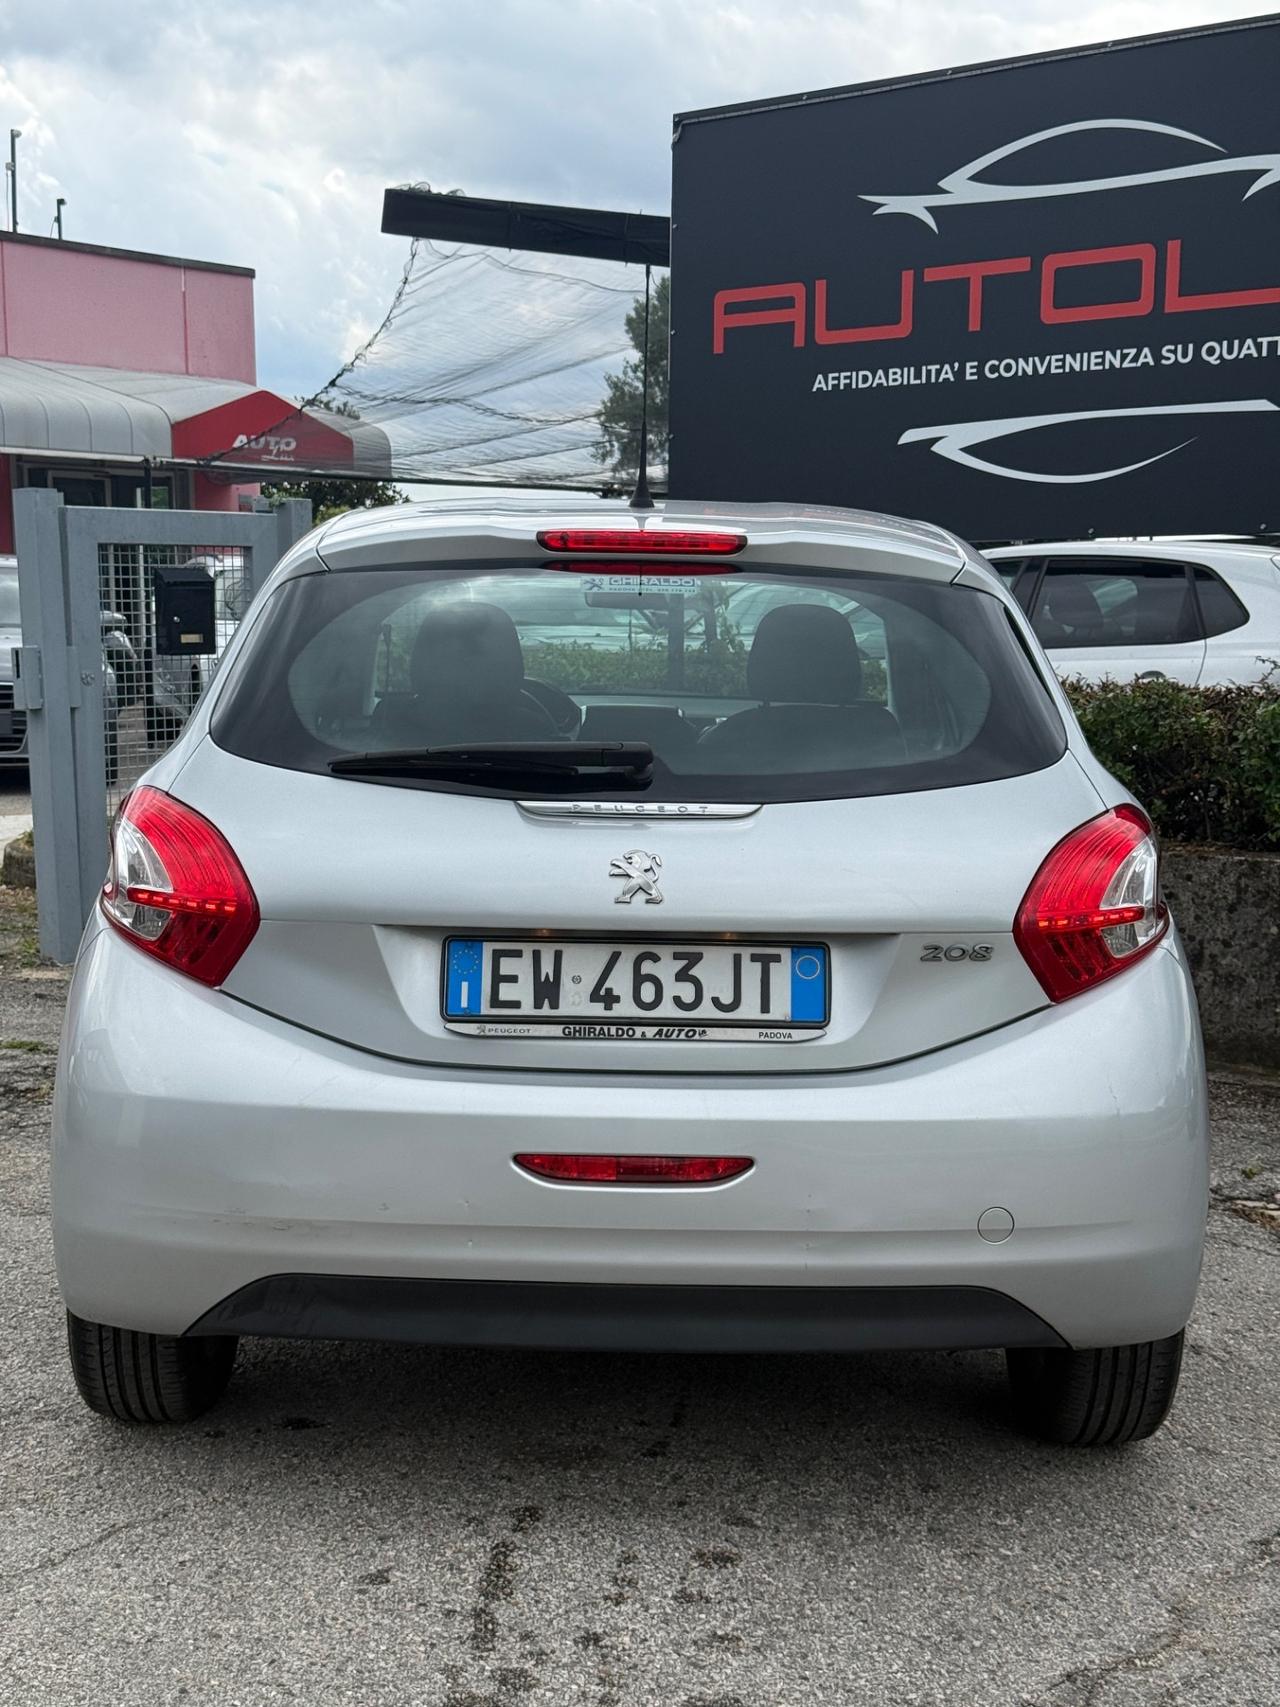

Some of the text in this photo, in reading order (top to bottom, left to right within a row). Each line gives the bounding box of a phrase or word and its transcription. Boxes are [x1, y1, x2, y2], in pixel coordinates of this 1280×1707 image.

[713, 239, 1280, 354] AUTOL
[965, 361, 979, 381] E
[984, 346, 1155, 379] CONVENIENZA
[1160, 343, 1194, 365] SU
[232, 433, 297, 451] AUTO
[610, 576, 695, 586] GHIRALDO
[570, 803, 708, 814] PEUGEOT
[919, 943, 994, 962] 208
[489, 948, 563, 1009] EW
[487, 1027, 531, 1035] PEUGEOT
[562, 1026, 636, 1038] GHIRALDO
[640, 1030, 647, 1038] &
[758, 1031, 793, 1040] PADOVA
